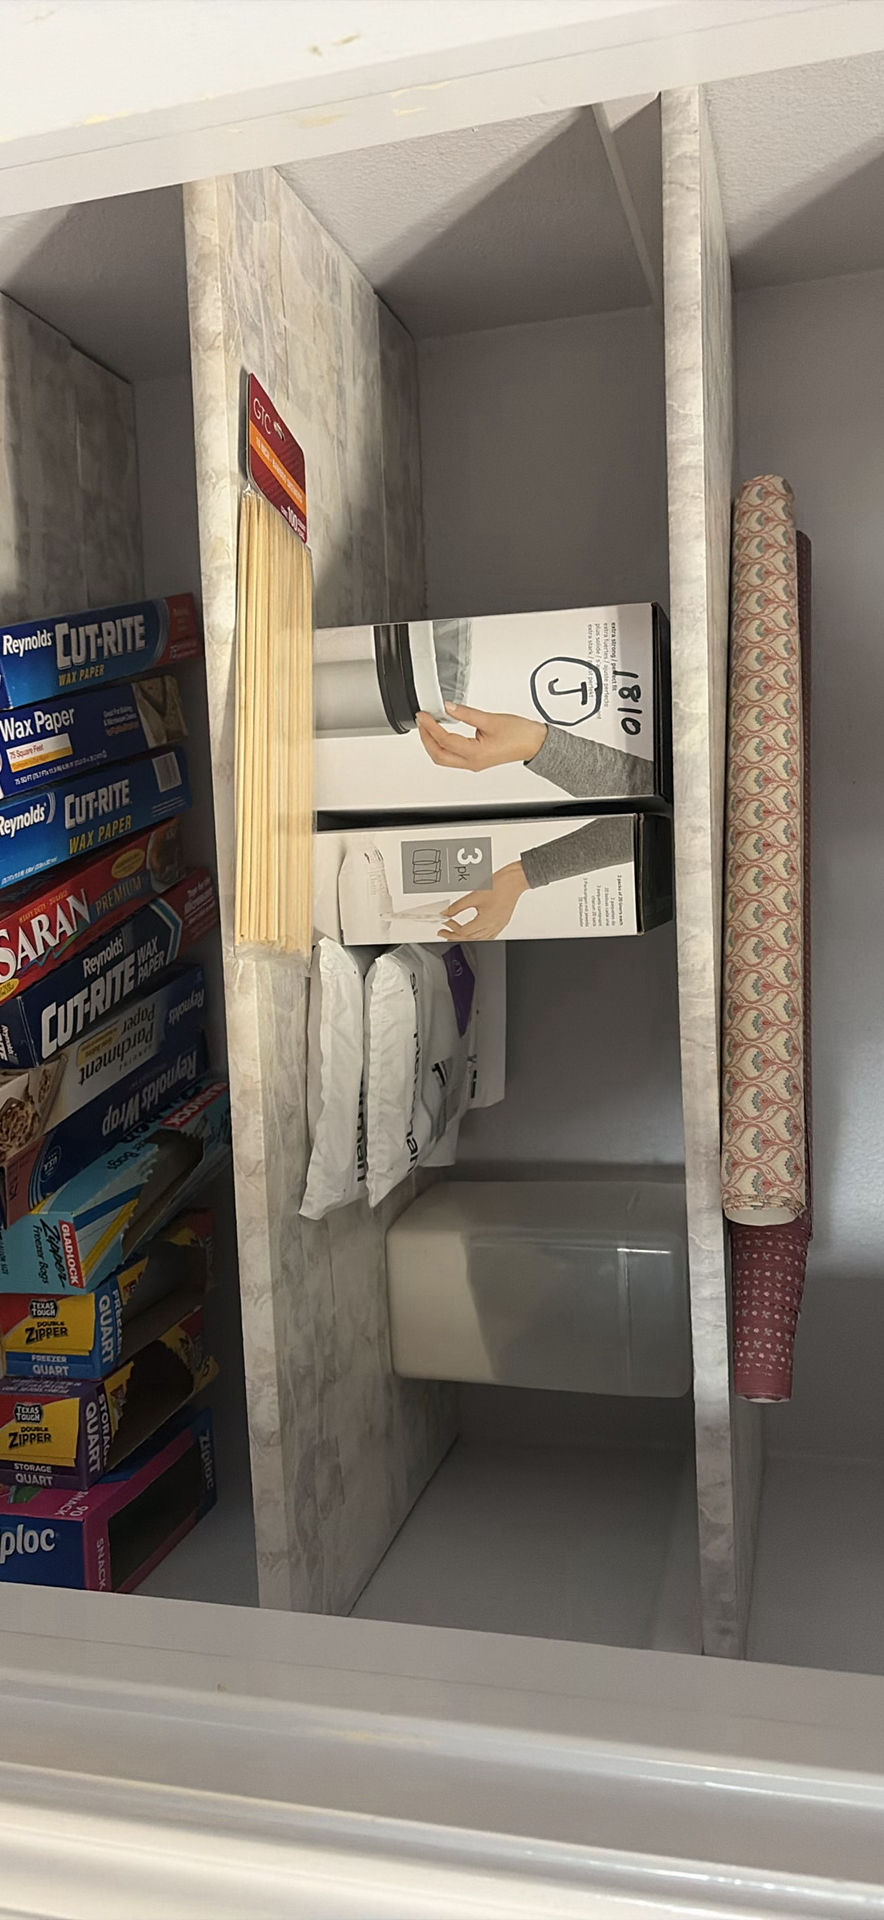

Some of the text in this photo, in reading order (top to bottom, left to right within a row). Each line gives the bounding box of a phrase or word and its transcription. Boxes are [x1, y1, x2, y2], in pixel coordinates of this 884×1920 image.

[253, 398, 272, 435] GTC
[3, 629, 52, 658] Reynolds
[55, 614, 146, 670] CUT-RITE
[58, 664, 105, 687] WAX PAPER
[602, 683, 610, 708] perfecto
[613, 669, 643, 735] 1810
[0, 716, 33, 742] Wax
[34, 707, 75, 734] Paper
[0, 803, 47, 838] Reynolds
[64, 778, 131, 830] CUT-RITE
[69, 815, 132, 855] WAX PAPER
[453, 866, 471, 882] pk
[457, 848, 483, 865] 3
[95, 875, 143, 917] PREMIUM
[0, 887, 92, 984] SARAN
[137, 936, 159, 964] WAX
[82, 935, 124, 979] Reynolds
[137, 950, 166, 985] PAPER
[41, 950, 136, 1060] CUT-RITE
[121, 1001, 156, 1035] Paper
[168, 989, 205, 1026] Reynolds
[78, 1022, 155, 1086] Parchment
[141, 1050, 198, 1111] Reynolds
[102, 1093, 141, 1137] Wrap
[33, 1224, 49, 1284] Freezer Bags
[31, 1301, 55, 1310] TEXAS
[31, 1308, 56, 1317] TOUGH
[25, 1327, 68, 1344] ZIPPER
[98, 1294, 114, 1363] QUART
[31, 1354, 67, 1363] FREEZER
[32, 1363, 69, 1376] QUART
[16, 1405, 40, 1414] TEXAS
[16, 1412, 41, 1422] TOUGH
[8, 1432, 52, 1449] ZIPPER
[85, 1401, 100, 1473] QUART
[14, 1463, 52, 1473] STORAGE
[198, 1428, 215, 1490] Ziploc
[15, 1473, 53, 1486] QUART
[69, 1505, 89, 1517] 90
[0, 1524, 56, 1564] ploc
[97, 1538, 107, 1590] SNACK
